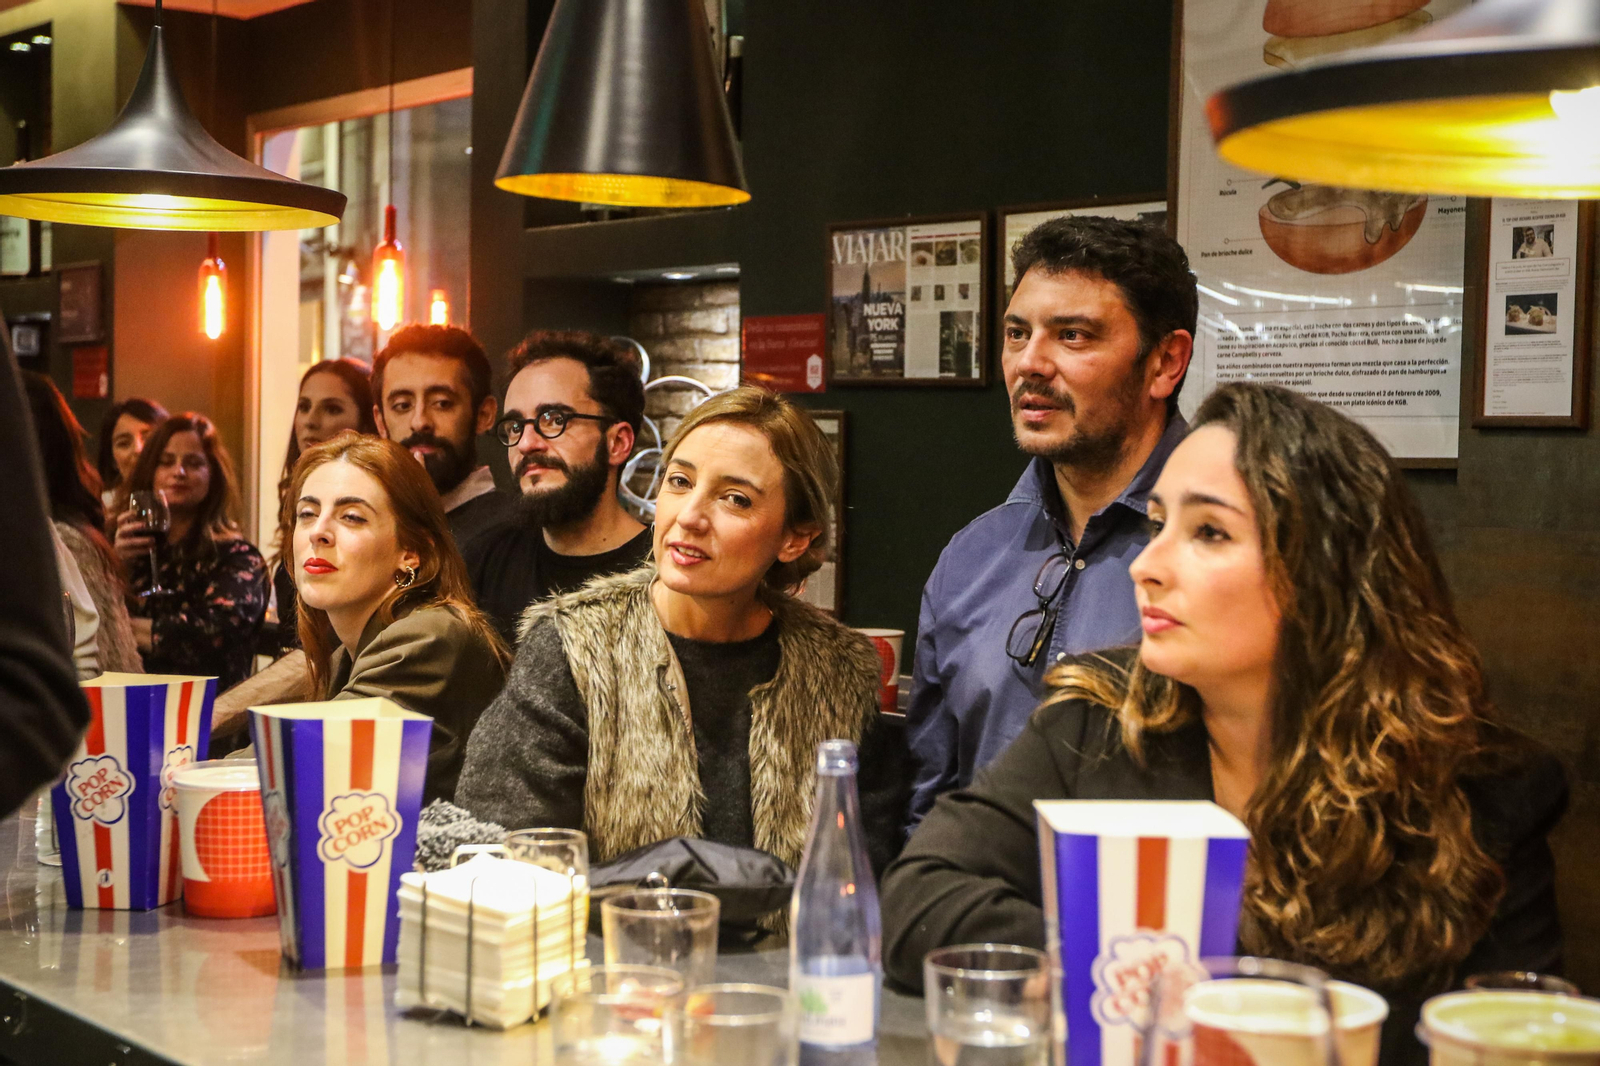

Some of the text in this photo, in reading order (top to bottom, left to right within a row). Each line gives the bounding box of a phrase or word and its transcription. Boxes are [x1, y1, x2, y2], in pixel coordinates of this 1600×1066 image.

[832, 231, 906, 267] VIAJAR
[864, 302, 903, 316] NUEVA
[867, 318, 899, 331] YORK
[1386, 320, 1400, 328] tipos
[1238, 342, 1264, 350] inspiración
[1273, 341, 1298, 349] Acapulco,
[1299, 340, 1318, 349] gracias
[1418, 358, 1449, 367] perfección.
[1335, 369, 1351, 377] dulce,
[1425, 389, 1442, 397] 2009,
[1351, 399, 1366, 407] plato
[78, 767, 108, 797] POP
[81, 775, 125, 812] CORN
[334, 805, 374, 834] POP
[333, 816, 389, 853] CORN
